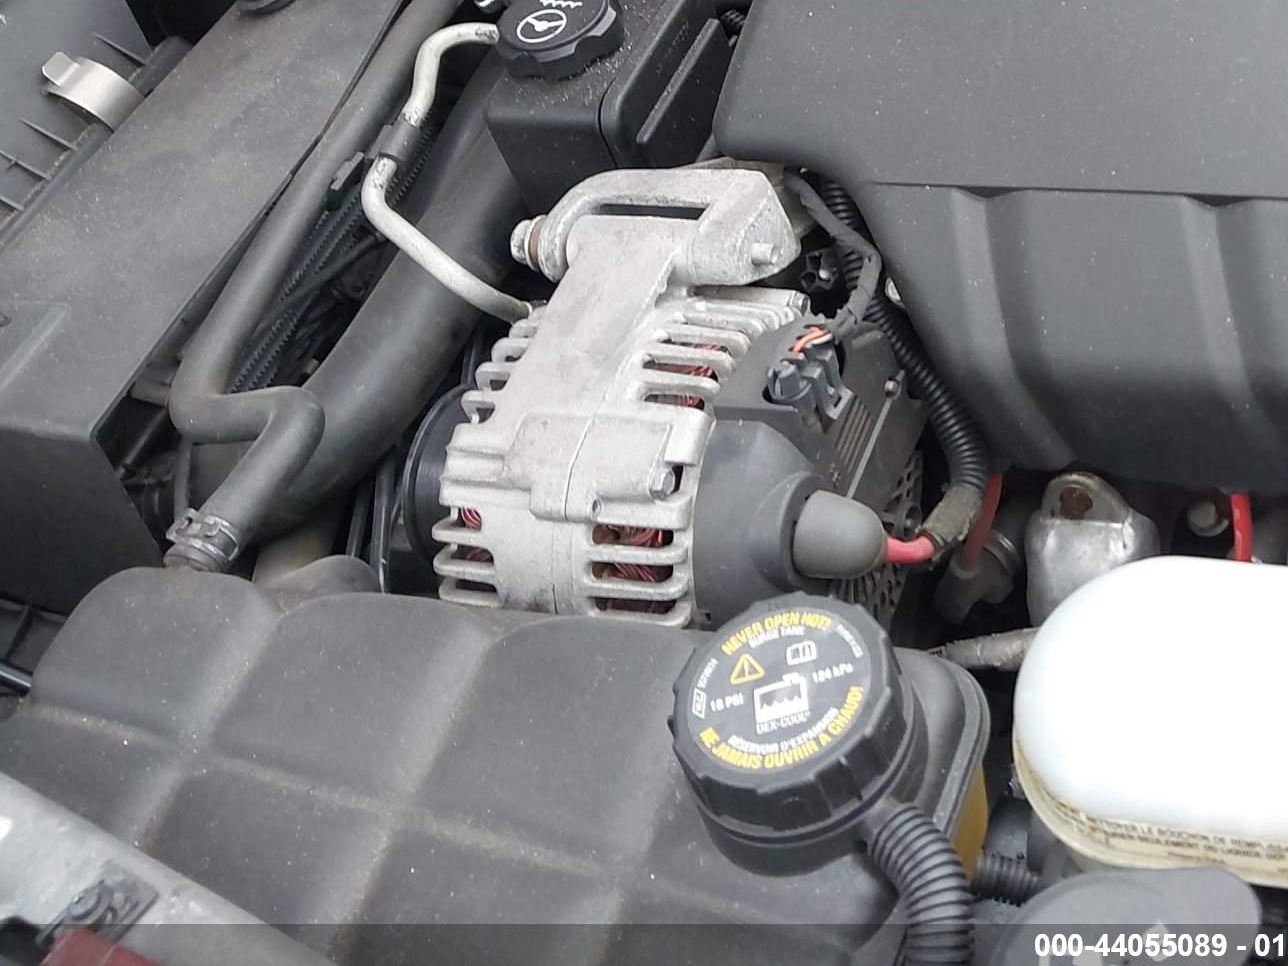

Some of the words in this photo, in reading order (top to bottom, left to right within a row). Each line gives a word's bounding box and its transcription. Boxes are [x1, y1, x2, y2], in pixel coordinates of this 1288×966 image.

[721, 622, 762, 656] NEVER
[763, 611, 801, 631] OPEN
[711, 741, 763, 769] JAMAIS
[763, 740, 820, 769] OUVRIR
